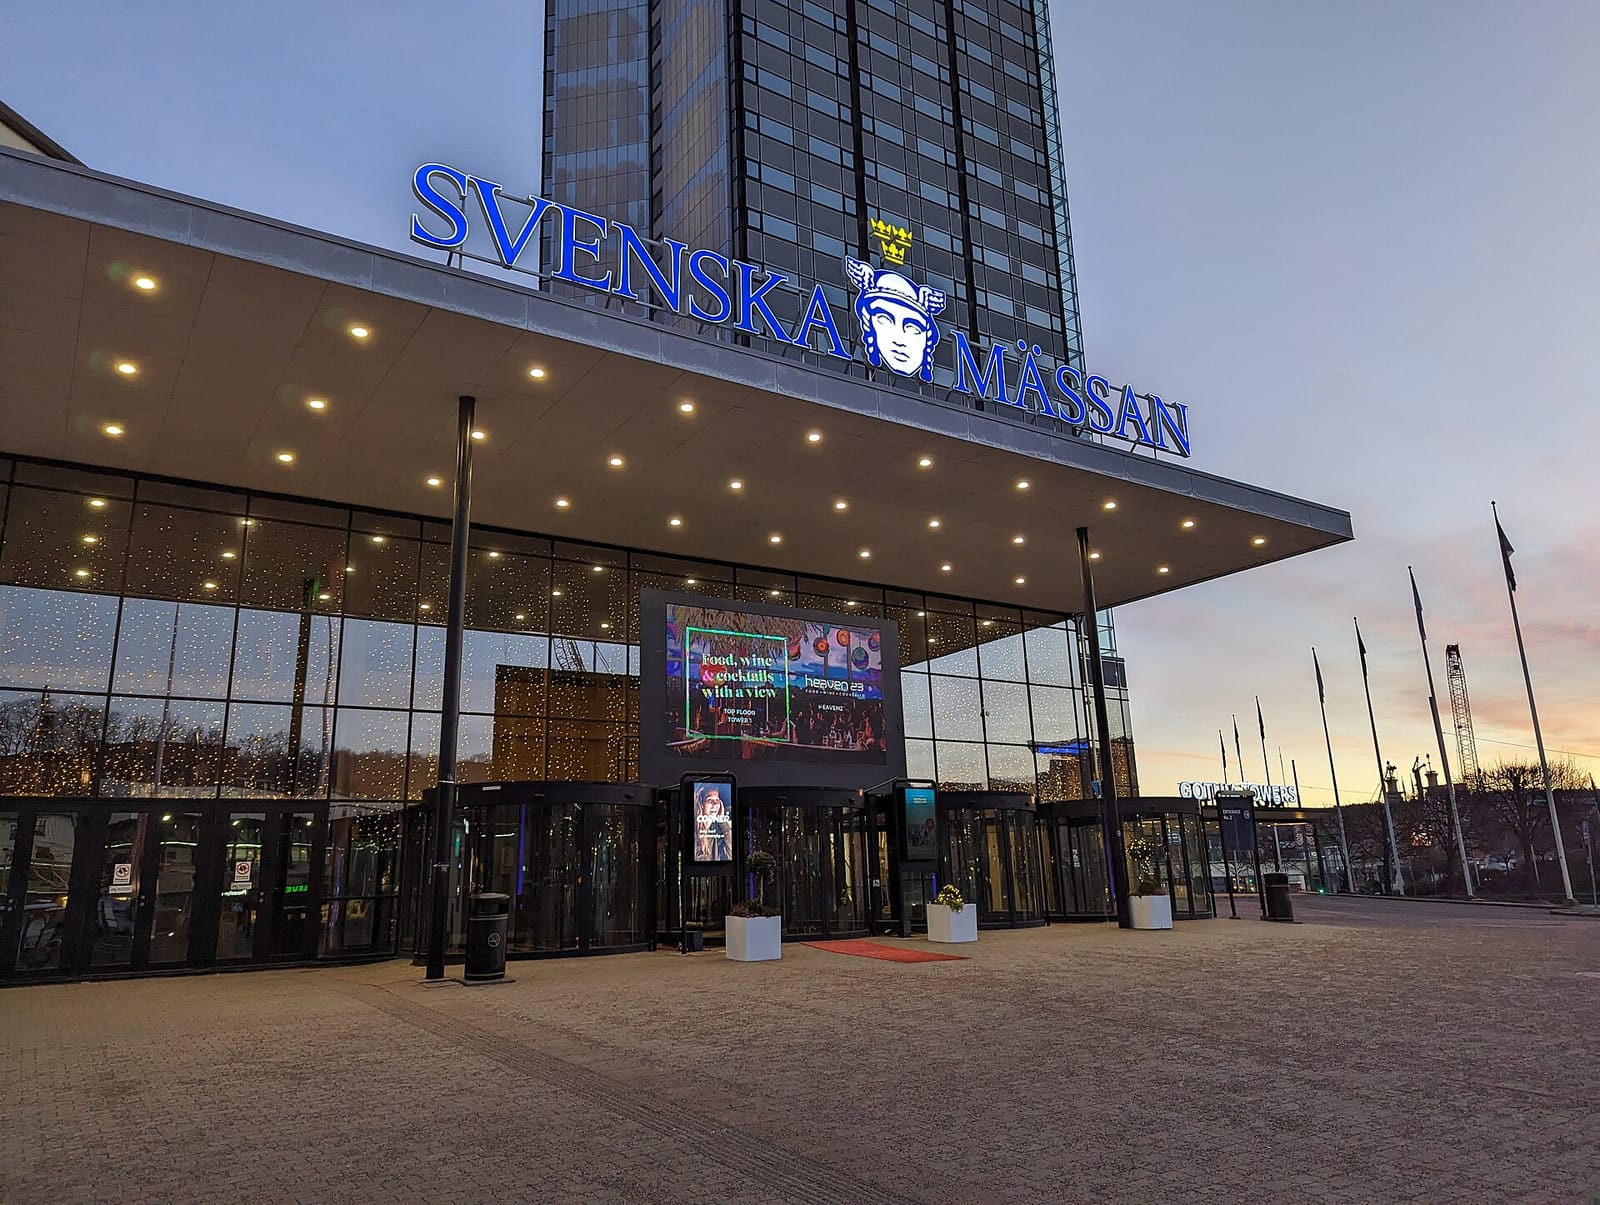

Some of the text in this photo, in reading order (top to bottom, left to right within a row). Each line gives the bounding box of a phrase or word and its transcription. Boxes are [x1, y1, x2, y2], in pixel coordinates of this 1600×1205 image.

[411, 162, 1190, 457] SVENSKA MÄSSAN
[701, 653, 773, 667] Food, wine
[702, 669, 775, 682] & cocktails
[804, 674, 864, 692] heaven 23
[701, 685, 778, 698] with a view
